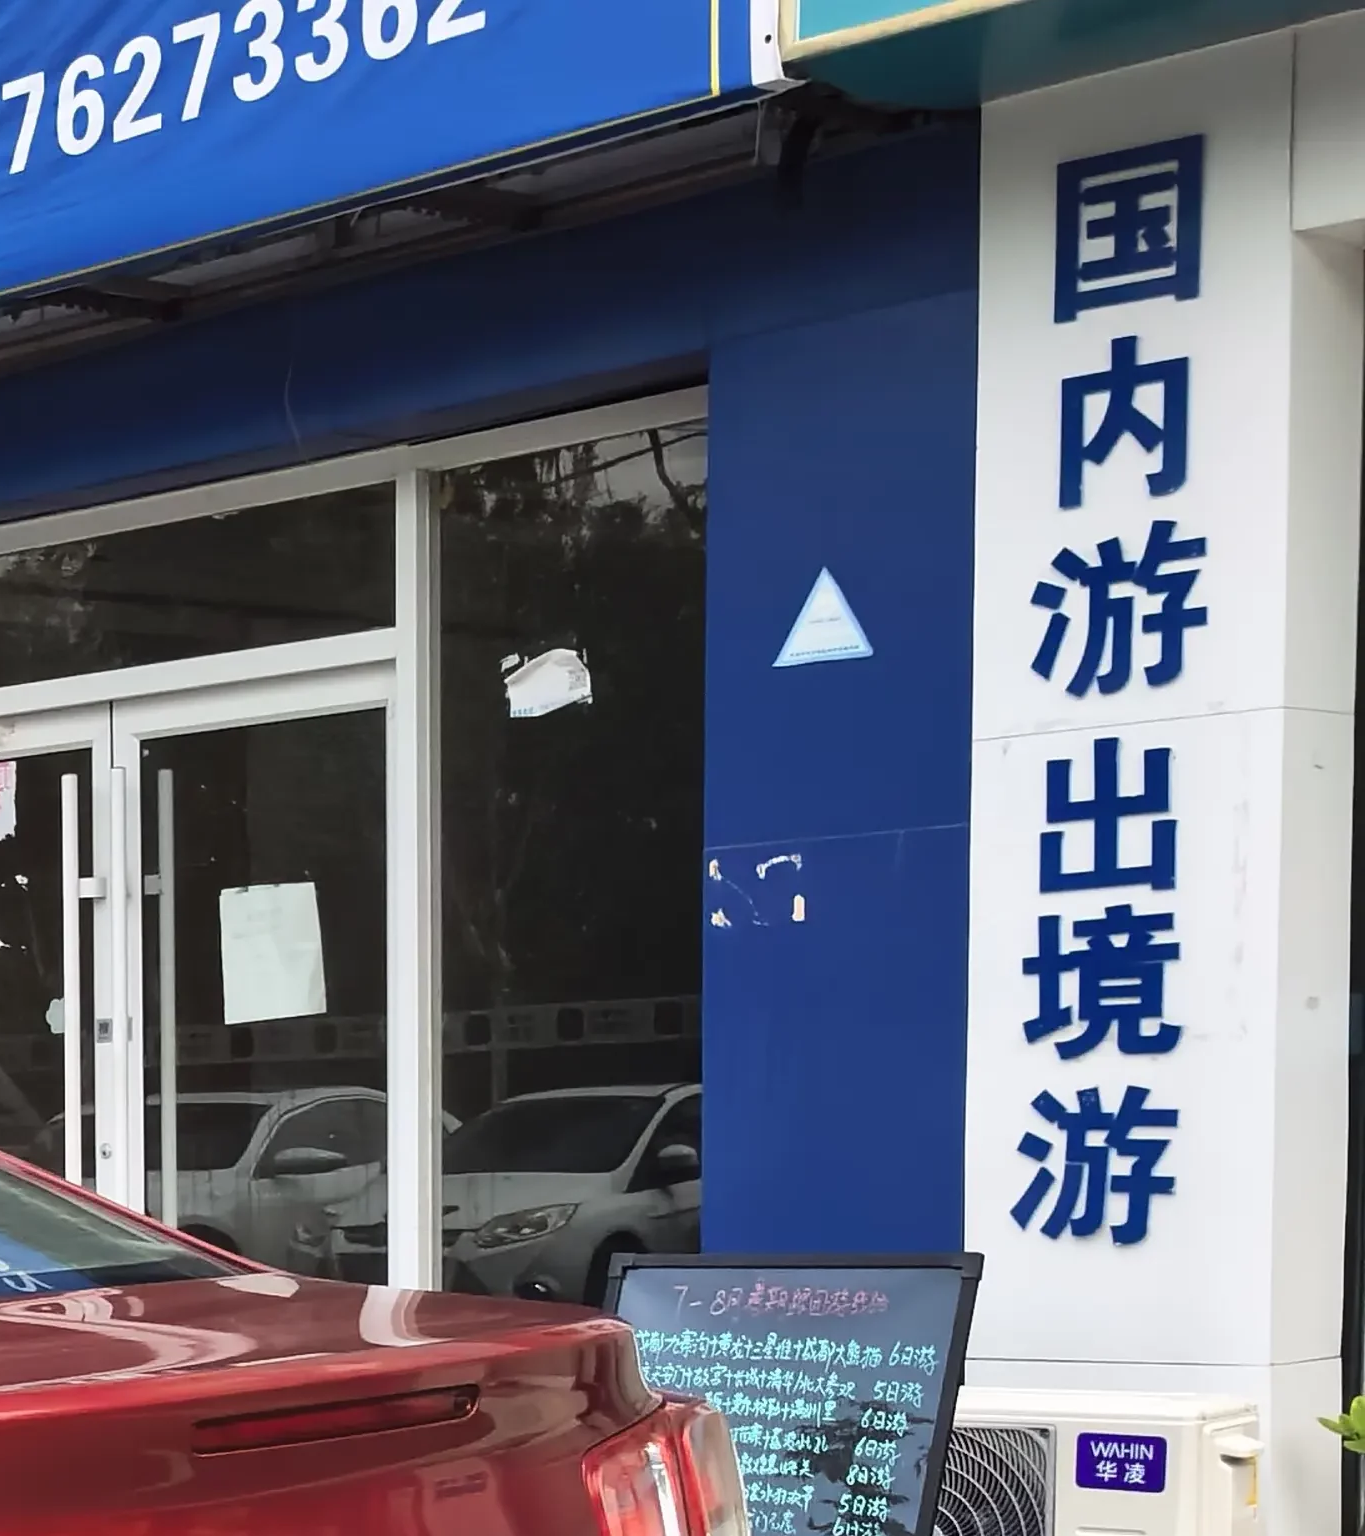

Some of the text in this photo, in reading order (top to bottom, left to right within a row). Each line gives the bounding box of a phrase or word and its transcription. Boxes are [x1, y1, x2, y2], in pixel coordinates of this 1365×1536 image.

[1009, 133, 1207, 1250] 国内游出境游
[889, 1340, 939, 1376] 6日游
[873, 1380, 925, 1407] 5日游
[861, 1408, 908, 1436] 6日游
[855, 1436, 901, 1466] 6日游
[1090, 1440, 1154, 1460] WAHIN
[846, 1464, 895, 1490] 8日游
[1096, 1460, 1146, 1484] 华凌
[839, 1494, 891, 1522] 5日游
